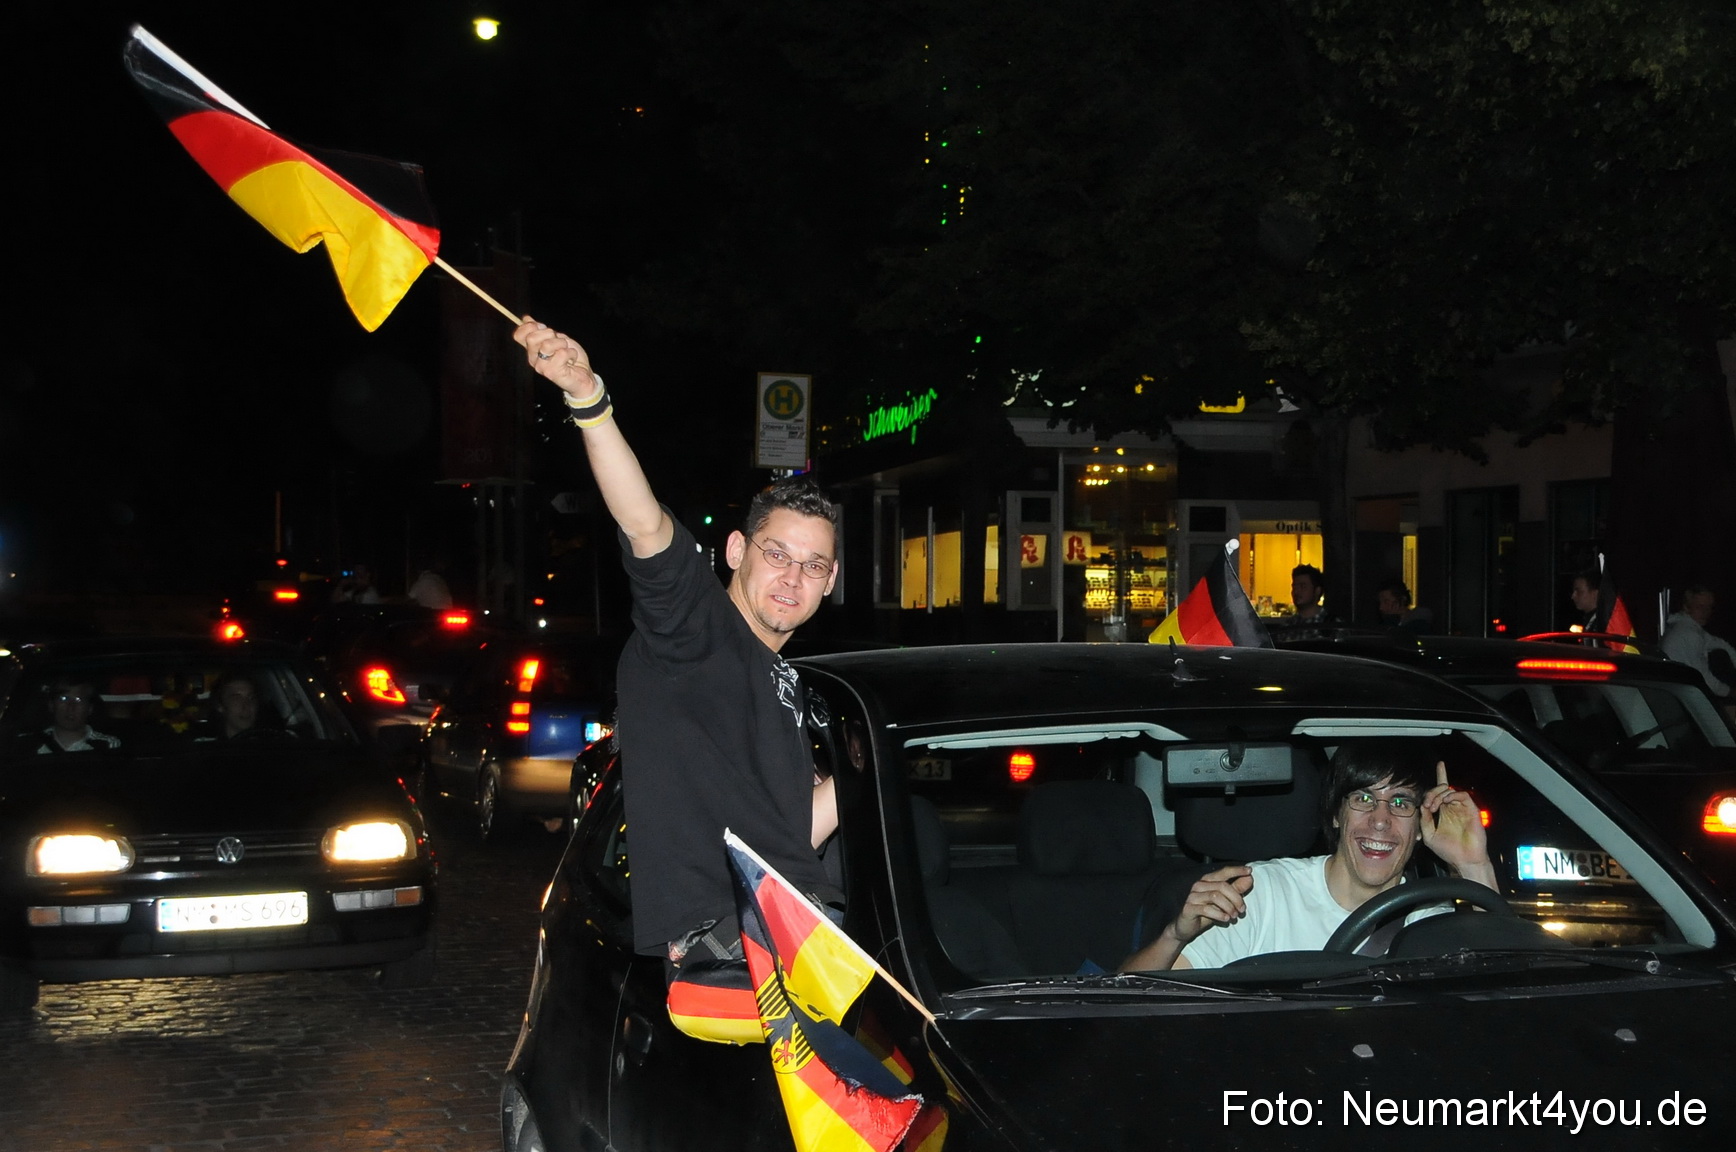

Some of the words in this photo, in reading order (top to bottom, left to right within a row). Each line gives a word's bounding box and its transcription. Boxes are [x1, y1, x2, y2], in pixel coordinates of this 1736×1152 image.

[774, 389, 793, 410] H
[1276, 521, 1311, 534] Optik
[1544, 852, 1575, 875] NM
[261, 899, 302, 920] 696
